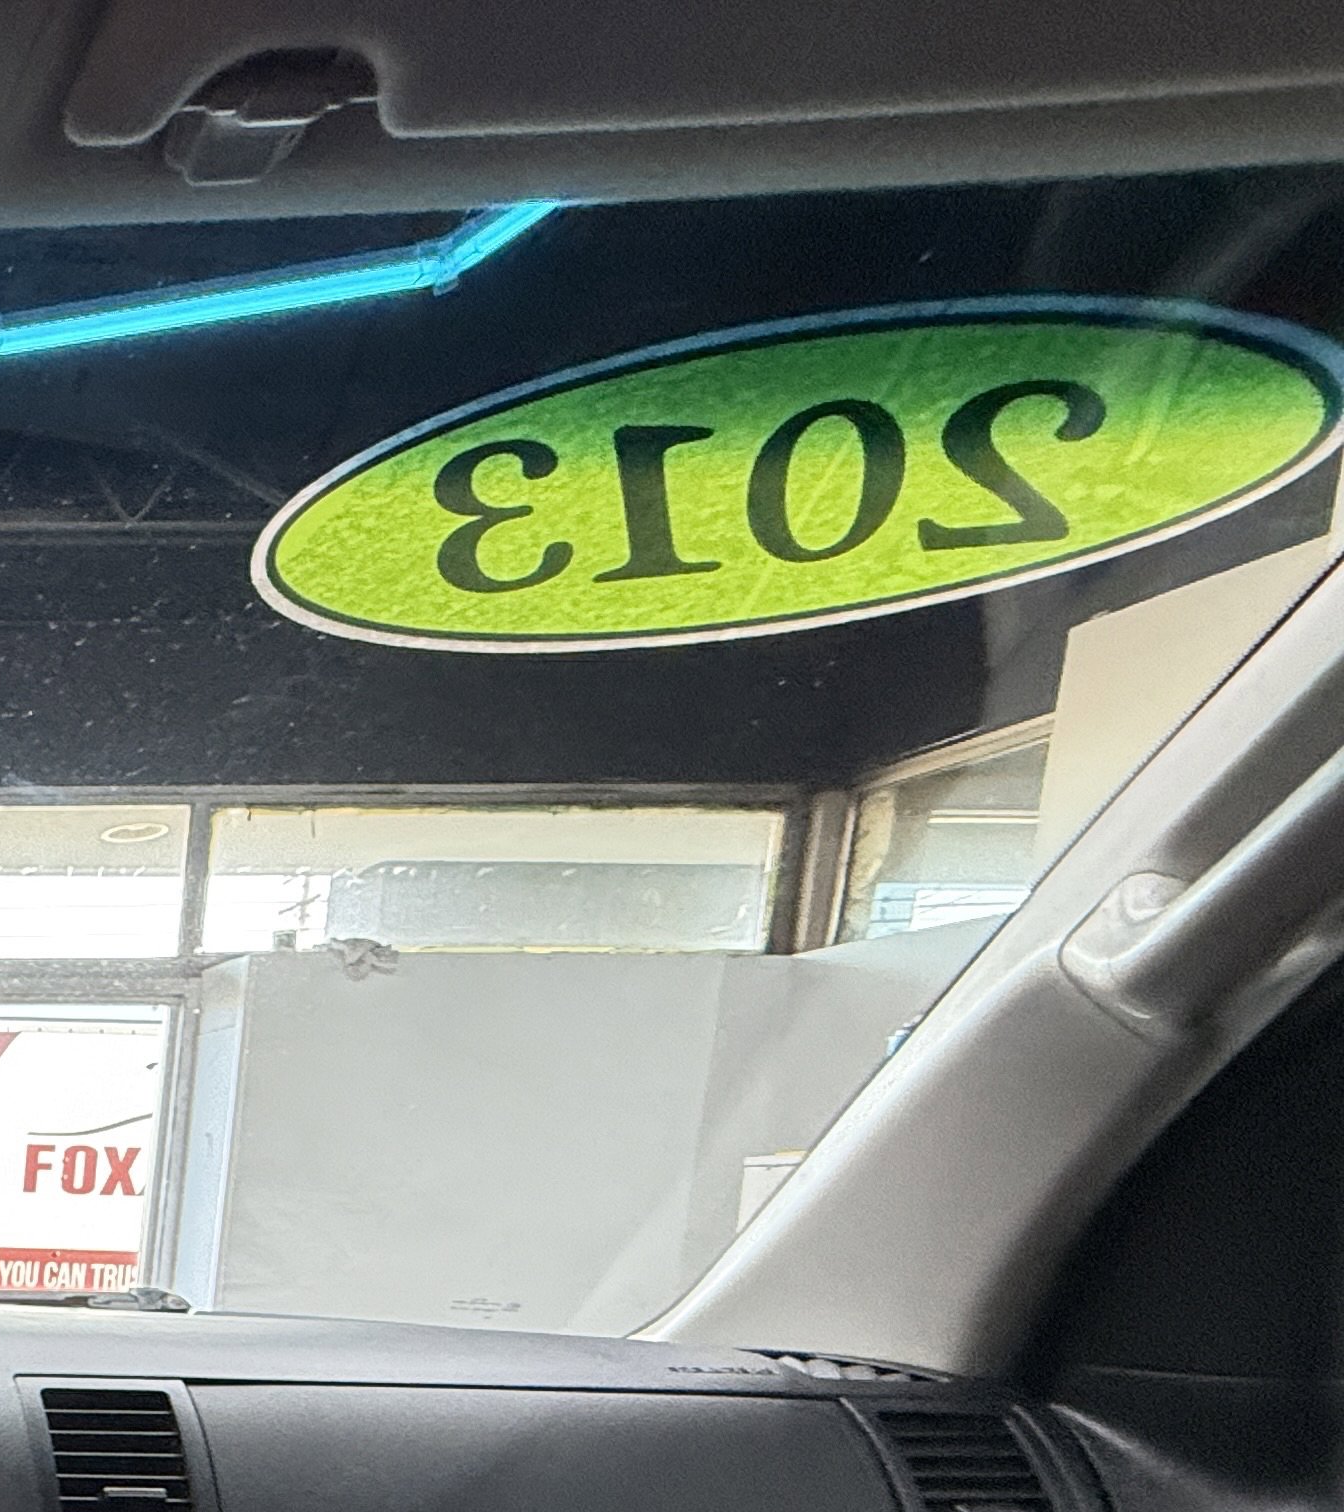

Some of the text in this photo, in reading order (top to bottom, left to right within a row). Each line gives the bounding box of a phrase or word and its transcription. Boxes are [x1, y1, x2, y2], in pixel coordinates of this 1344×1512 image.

[22, 1144, 142, 1196] FOX
[0, 1260, 40, 1289] YOU
[43, 1261, 87, 1290] CAN
